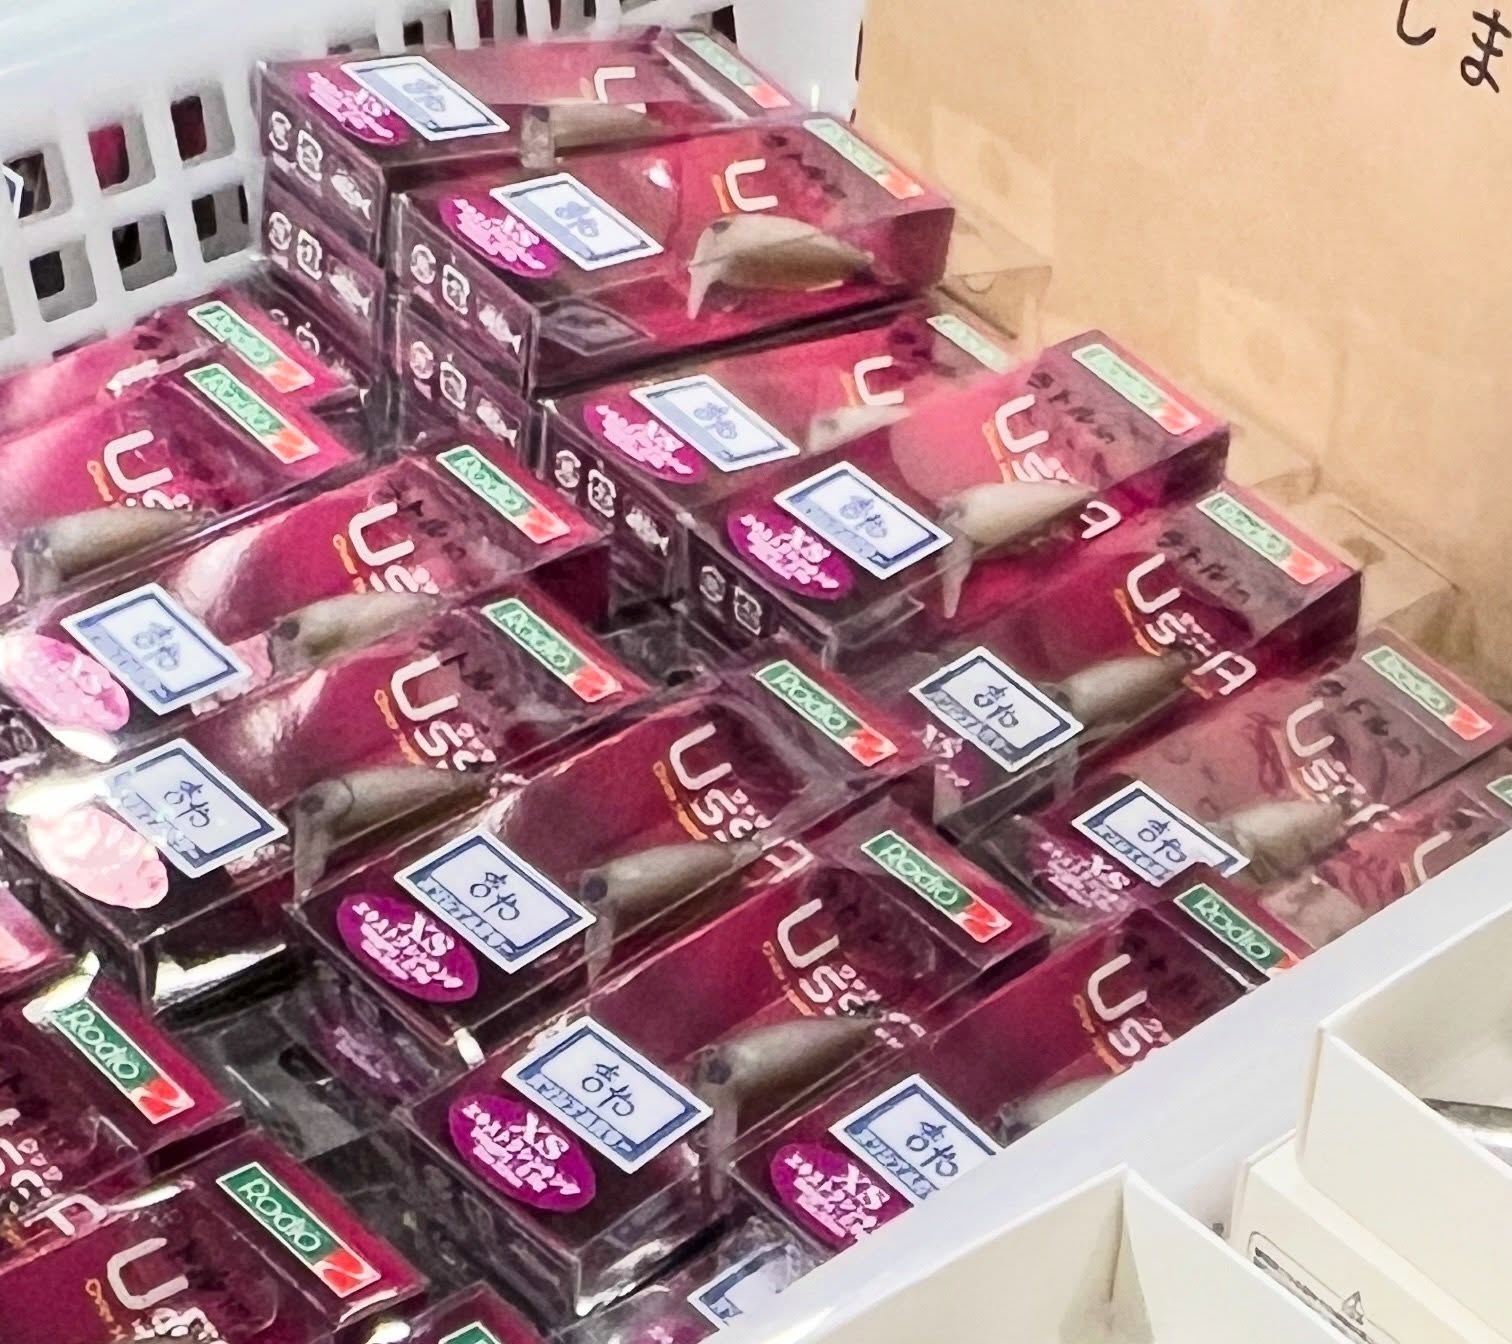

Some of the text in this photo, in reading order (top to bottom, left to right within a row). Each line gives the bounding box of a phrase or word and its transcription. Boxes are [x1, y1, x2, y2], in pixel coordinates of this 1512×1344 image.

[877, 845, 956, 907] Rodio
[1189, 896, 1274, 961] Rodio
[65, 1011, 142, 1081] Rodio
[519, 1106, 570, 1160] XS
[237, 1179, 322, 1254] Rodio
[839, 1161, 892, 1213] XS
